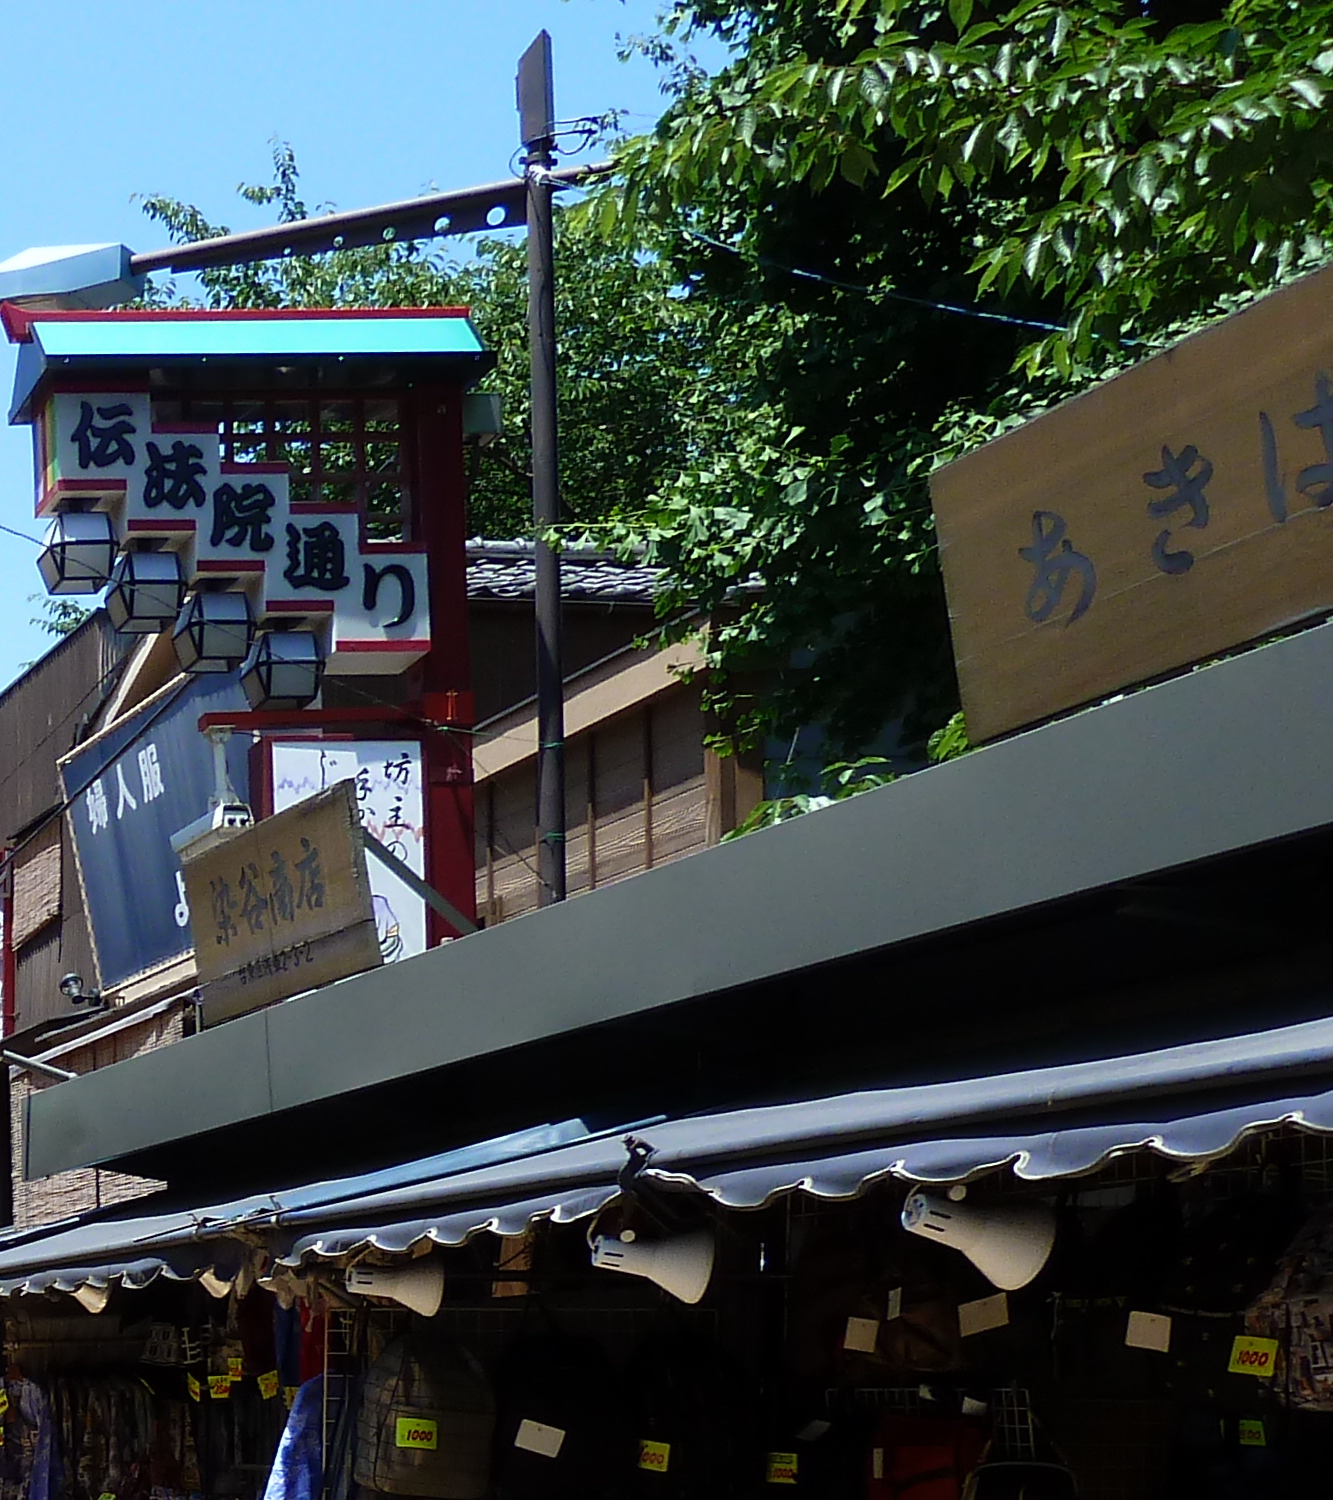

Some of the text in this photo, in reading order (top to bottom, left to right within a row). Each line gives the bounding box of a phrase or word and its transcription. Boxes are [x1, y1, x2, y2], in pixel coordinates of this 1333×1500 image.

[70, 400, 415, 629] 伝法院通り
[86, 743, 165, 835] 婦人服
[1234, 1351, 1269, 1366] 1000
[406, 1429, 433, 1442] 1000
